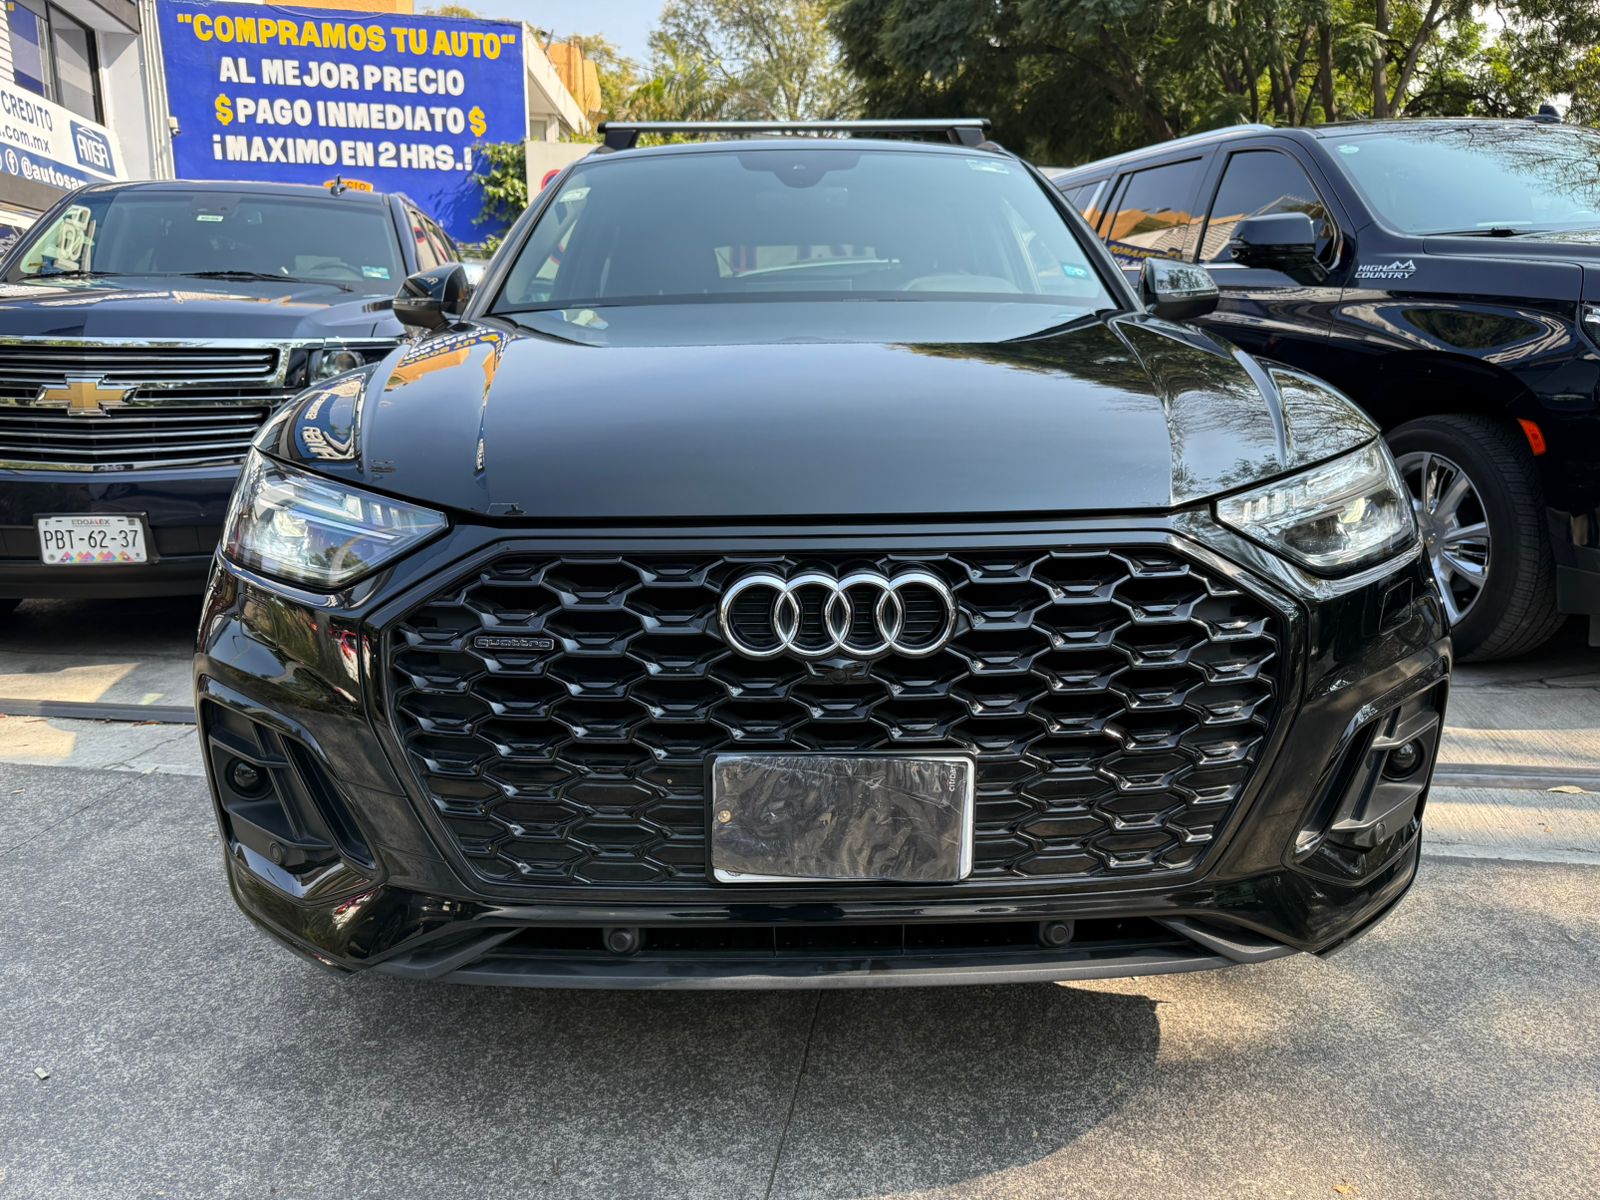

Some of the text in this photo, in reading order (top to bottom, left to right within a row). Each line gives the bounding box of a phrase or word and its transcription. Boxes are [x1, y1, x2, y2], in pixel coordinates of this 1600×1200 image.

[391, 27, 428, 56] TU
[219, 56, 465, 96] AL MEJOR PRECIO
[1, 90, 53, 133] CREDITO
[0, 125, 51, 154] .com.mx
[340, 140, 375, 167] EN
[378, 141, 398, 168] 2
[1354, 271, 1413, 279] COUNTRY
[1358, 264, 1388, 272] HIGH
[43, 529, 138, 550] PBT-62-37
